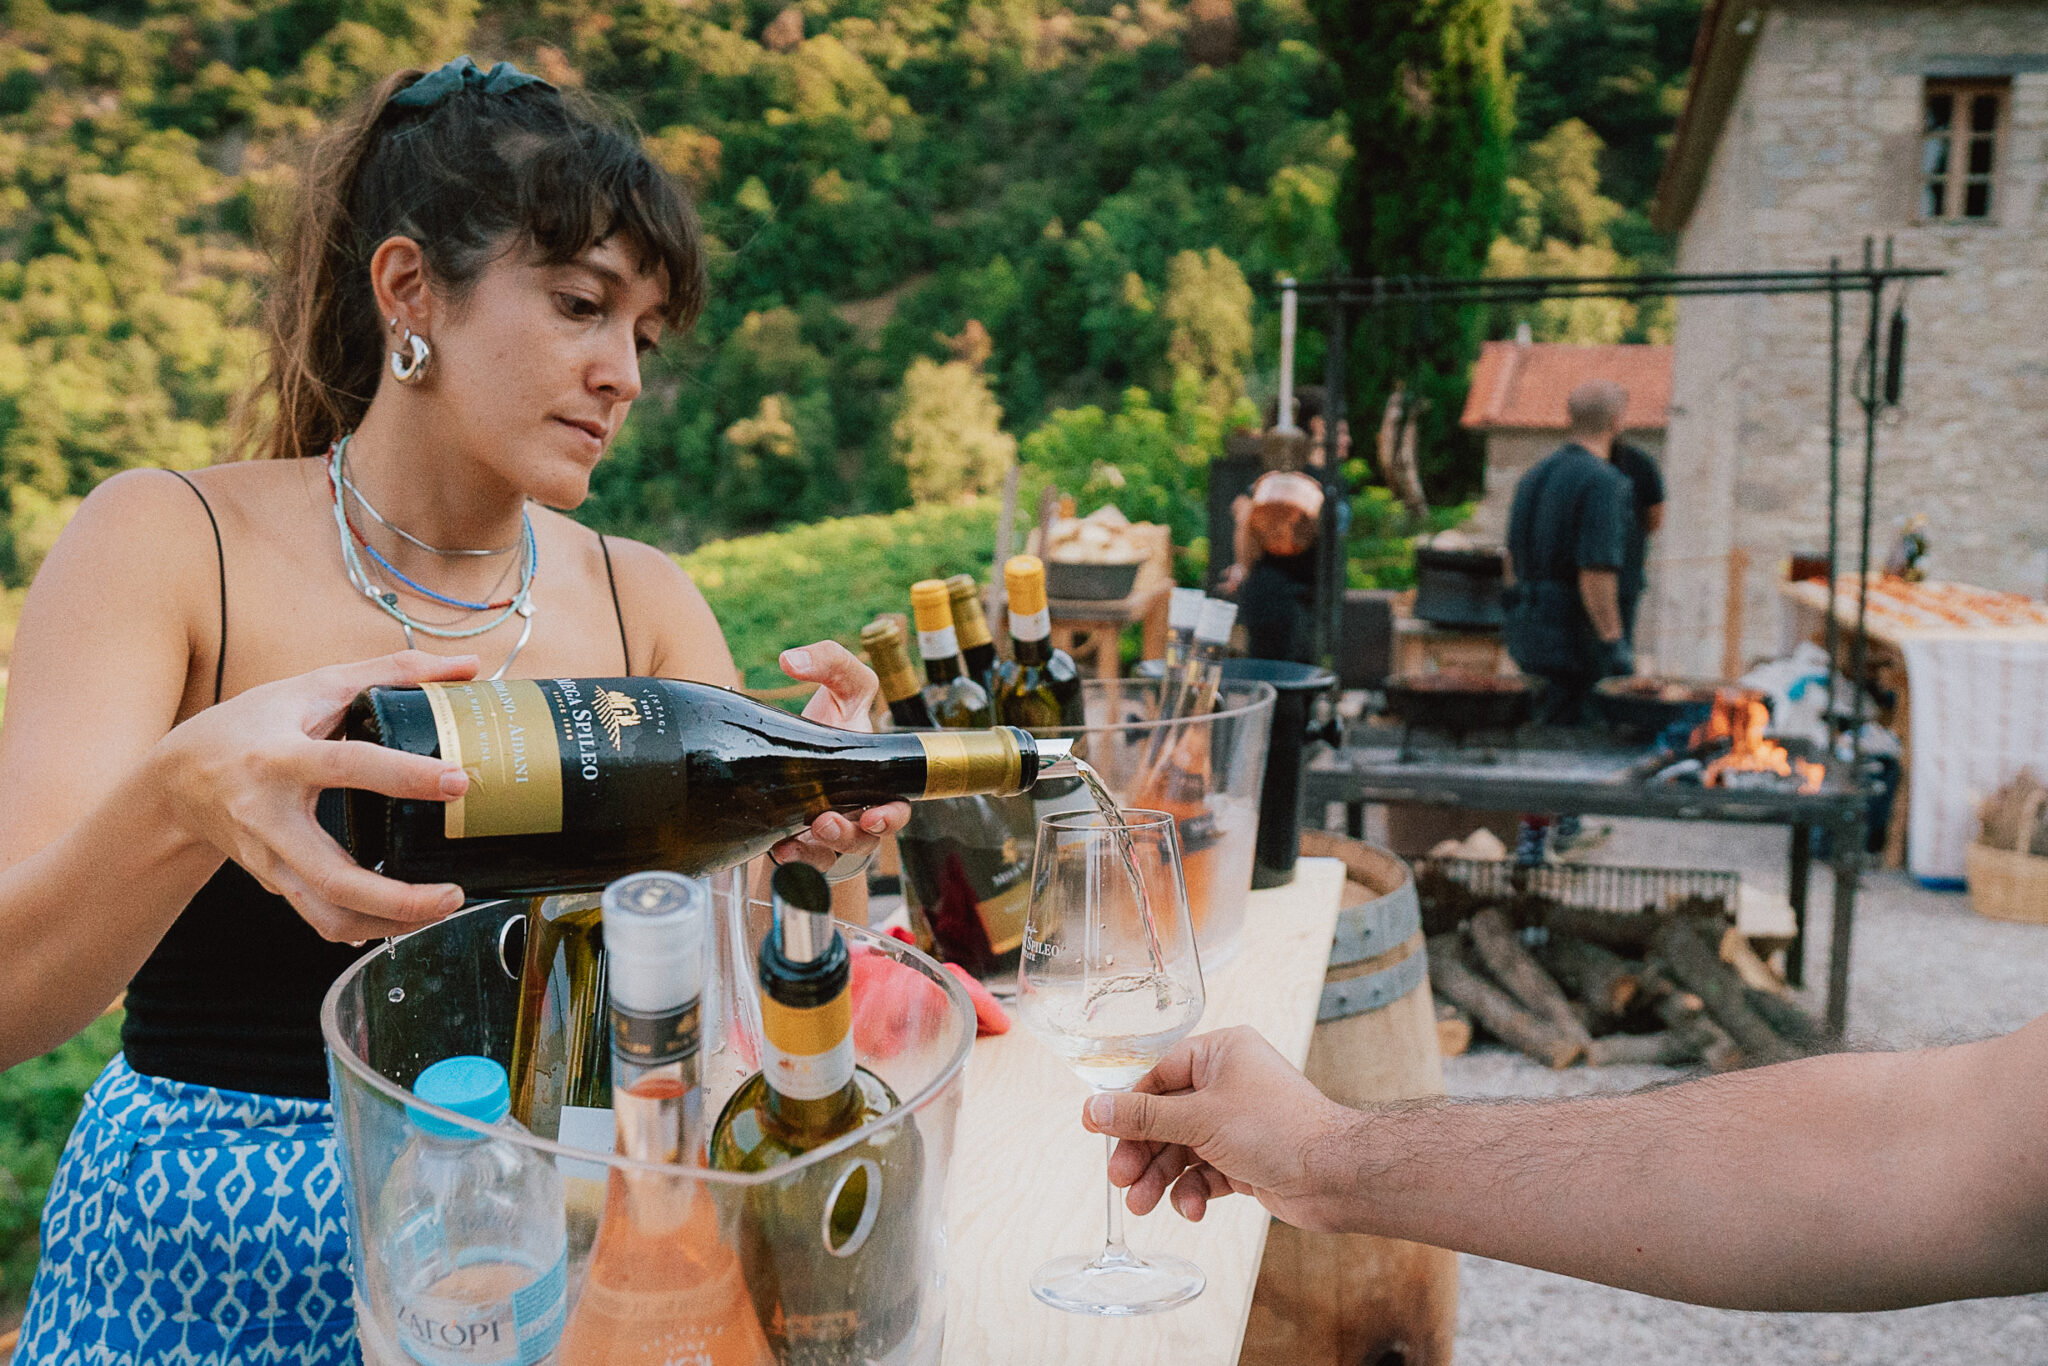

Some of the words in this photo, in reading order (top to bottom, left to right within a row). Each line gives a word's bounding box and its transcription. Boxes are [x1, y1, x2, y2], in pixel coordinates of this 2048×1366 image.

[552, 690, 568, 714] SINCE
[640, 699, 654, 721] 2021
[642, 688, 666, 735] VINTAGE
[470, 697, 486, 727] WHITE
[479, 731, 492, 761] WINE
[553, 678, 583, 707] MEGA
[571, 709, 600, 781] SPILEO
[507, 723, 529, 783] AIDANI
[1026, 935, 1060, 958] SPILEO
